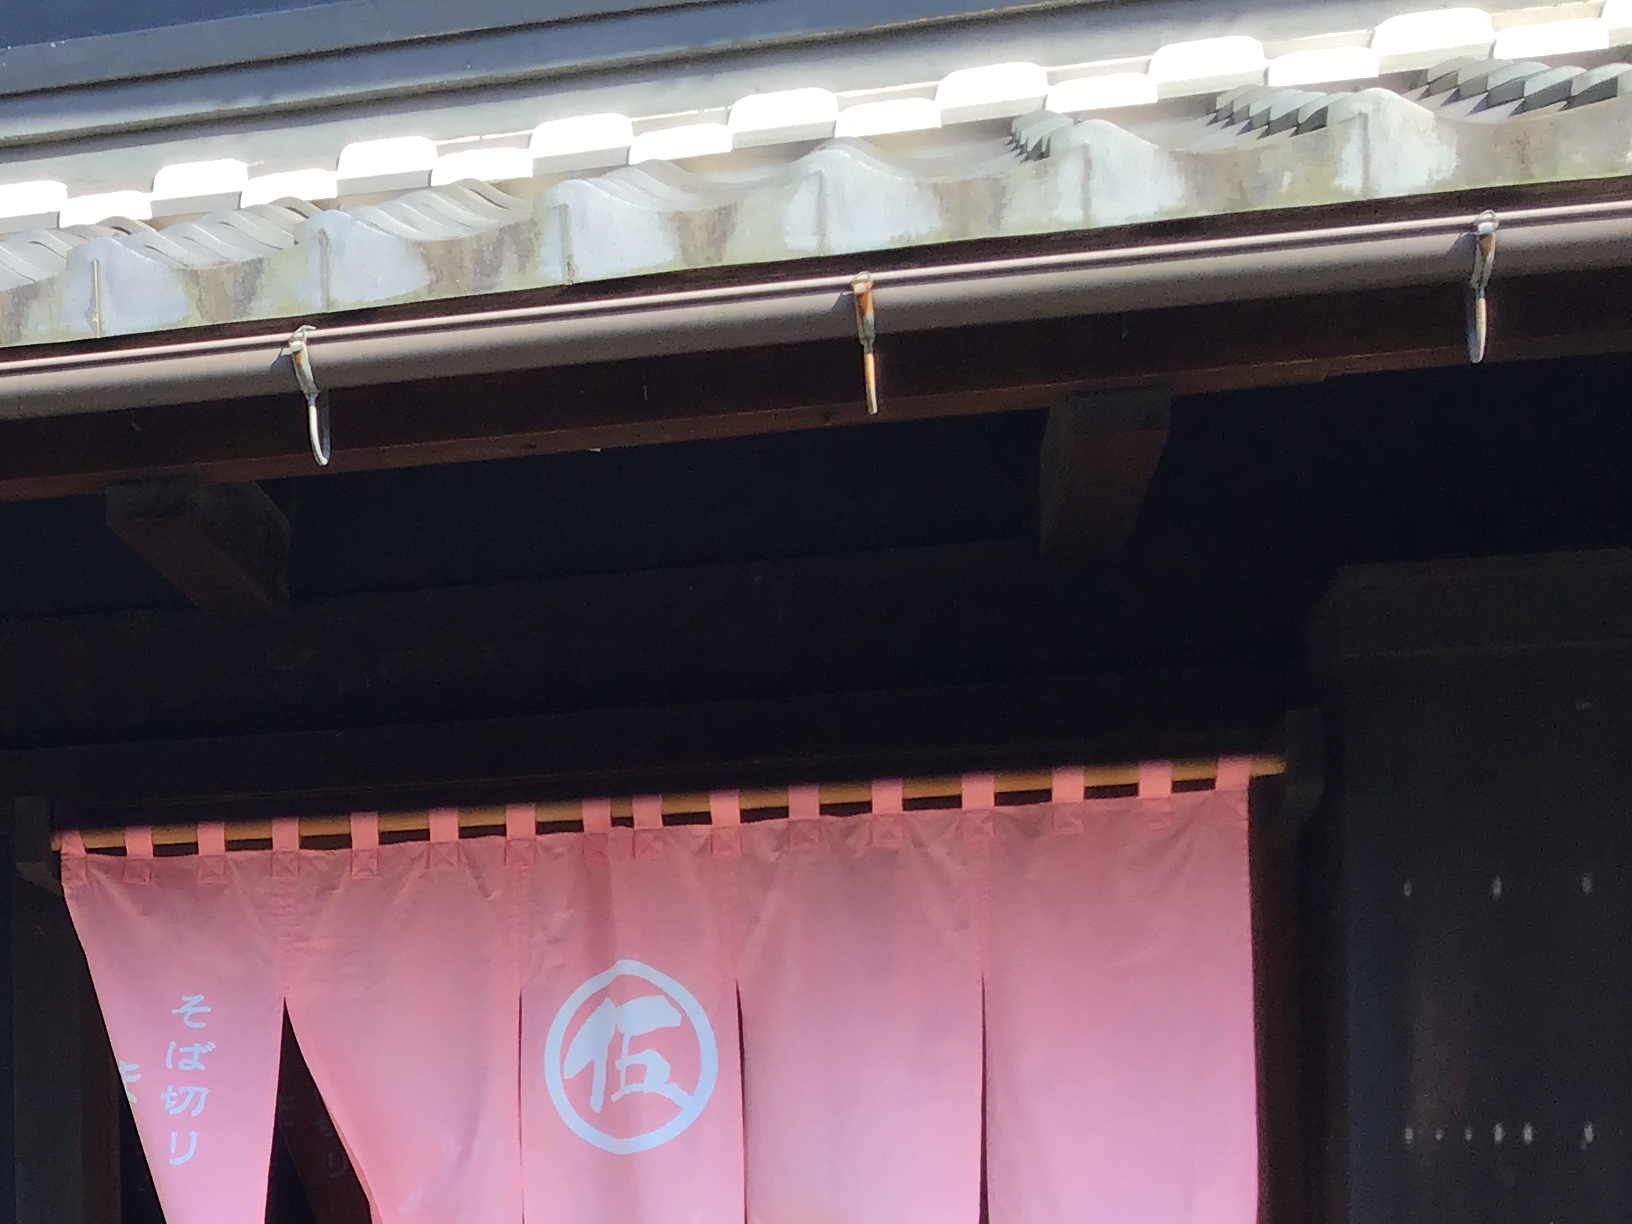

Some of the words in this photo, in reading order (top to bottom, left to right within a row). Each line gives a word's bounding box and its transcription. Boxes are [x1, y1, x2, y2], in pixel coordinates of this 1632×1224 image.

[161, 994, 216, 1165] そば切り
[564, 995, 693, 1113] 伍
